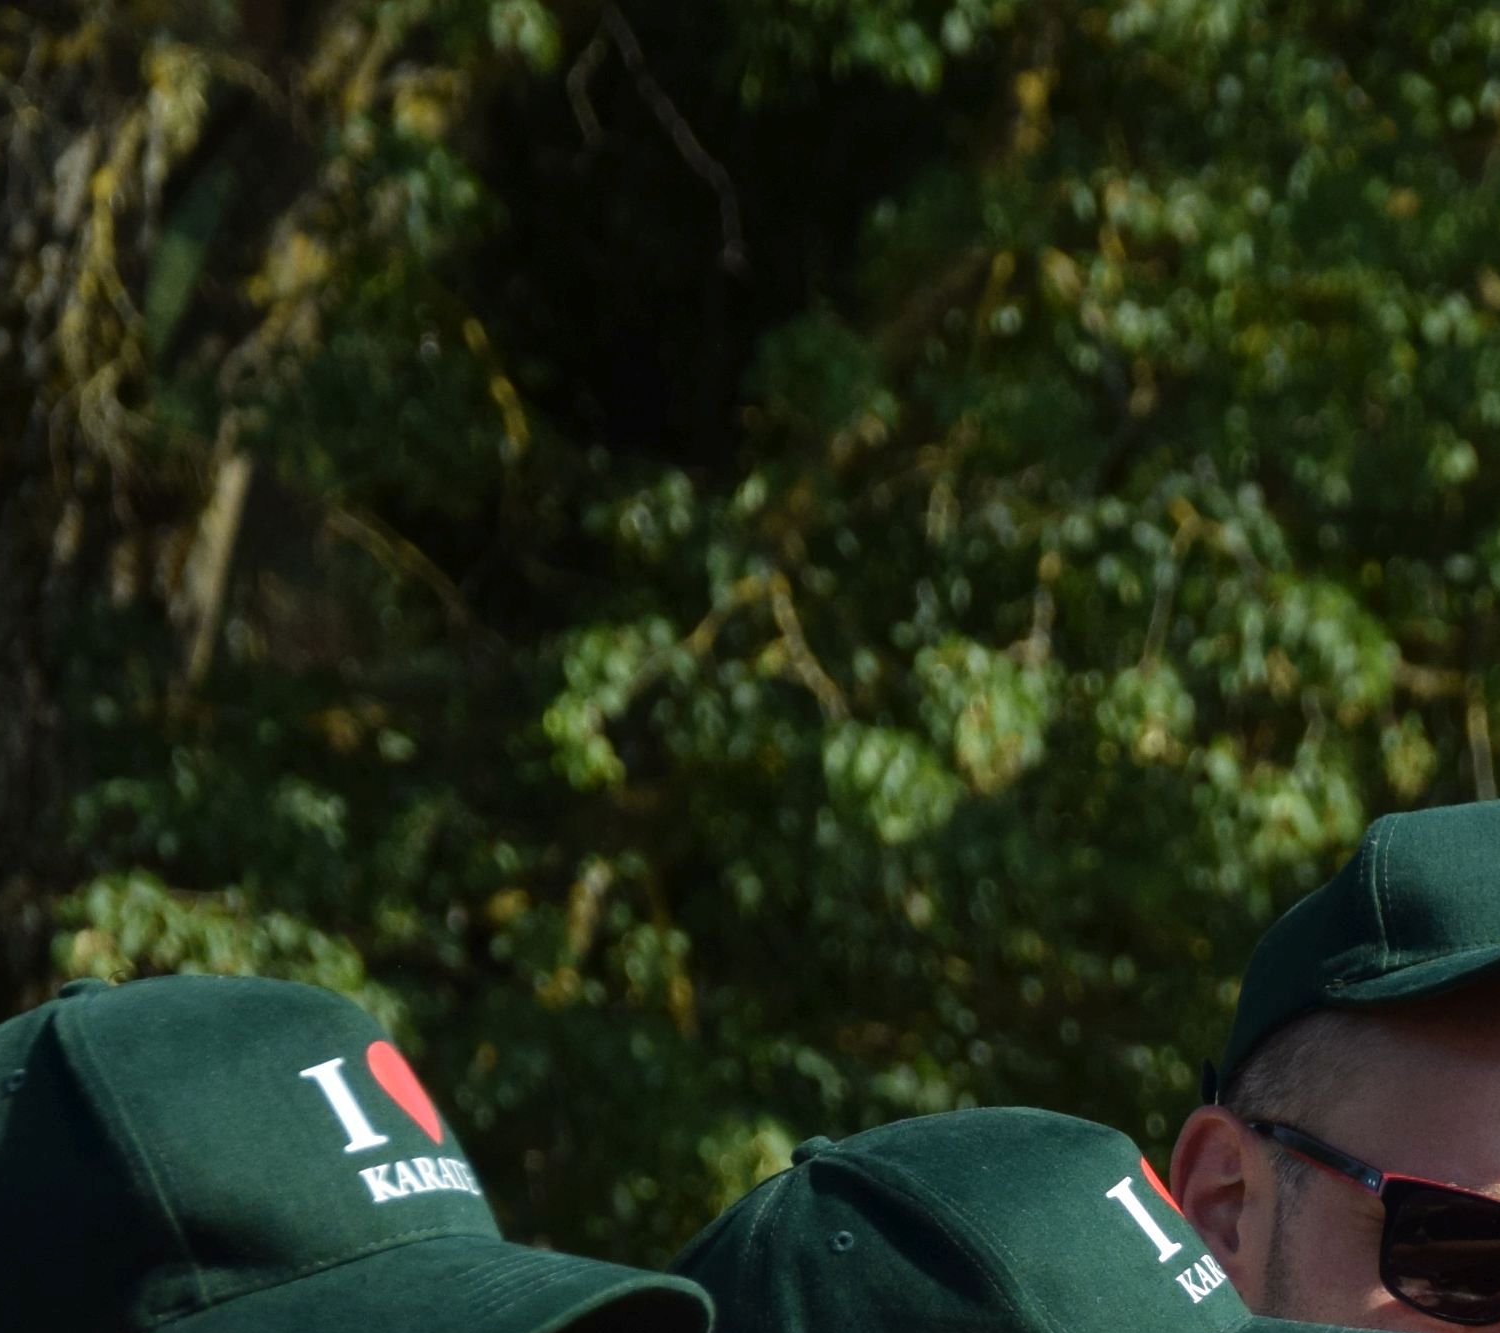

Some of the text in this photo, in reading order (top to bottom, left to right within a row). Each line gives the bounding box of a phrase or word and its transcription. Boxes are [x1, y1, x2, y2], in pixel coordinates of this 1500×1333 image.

[299, 1057, 390, 1153] I
[358, 1156, 482, 1204] KARATE
[1105, 1176, 1183, 1263] I
